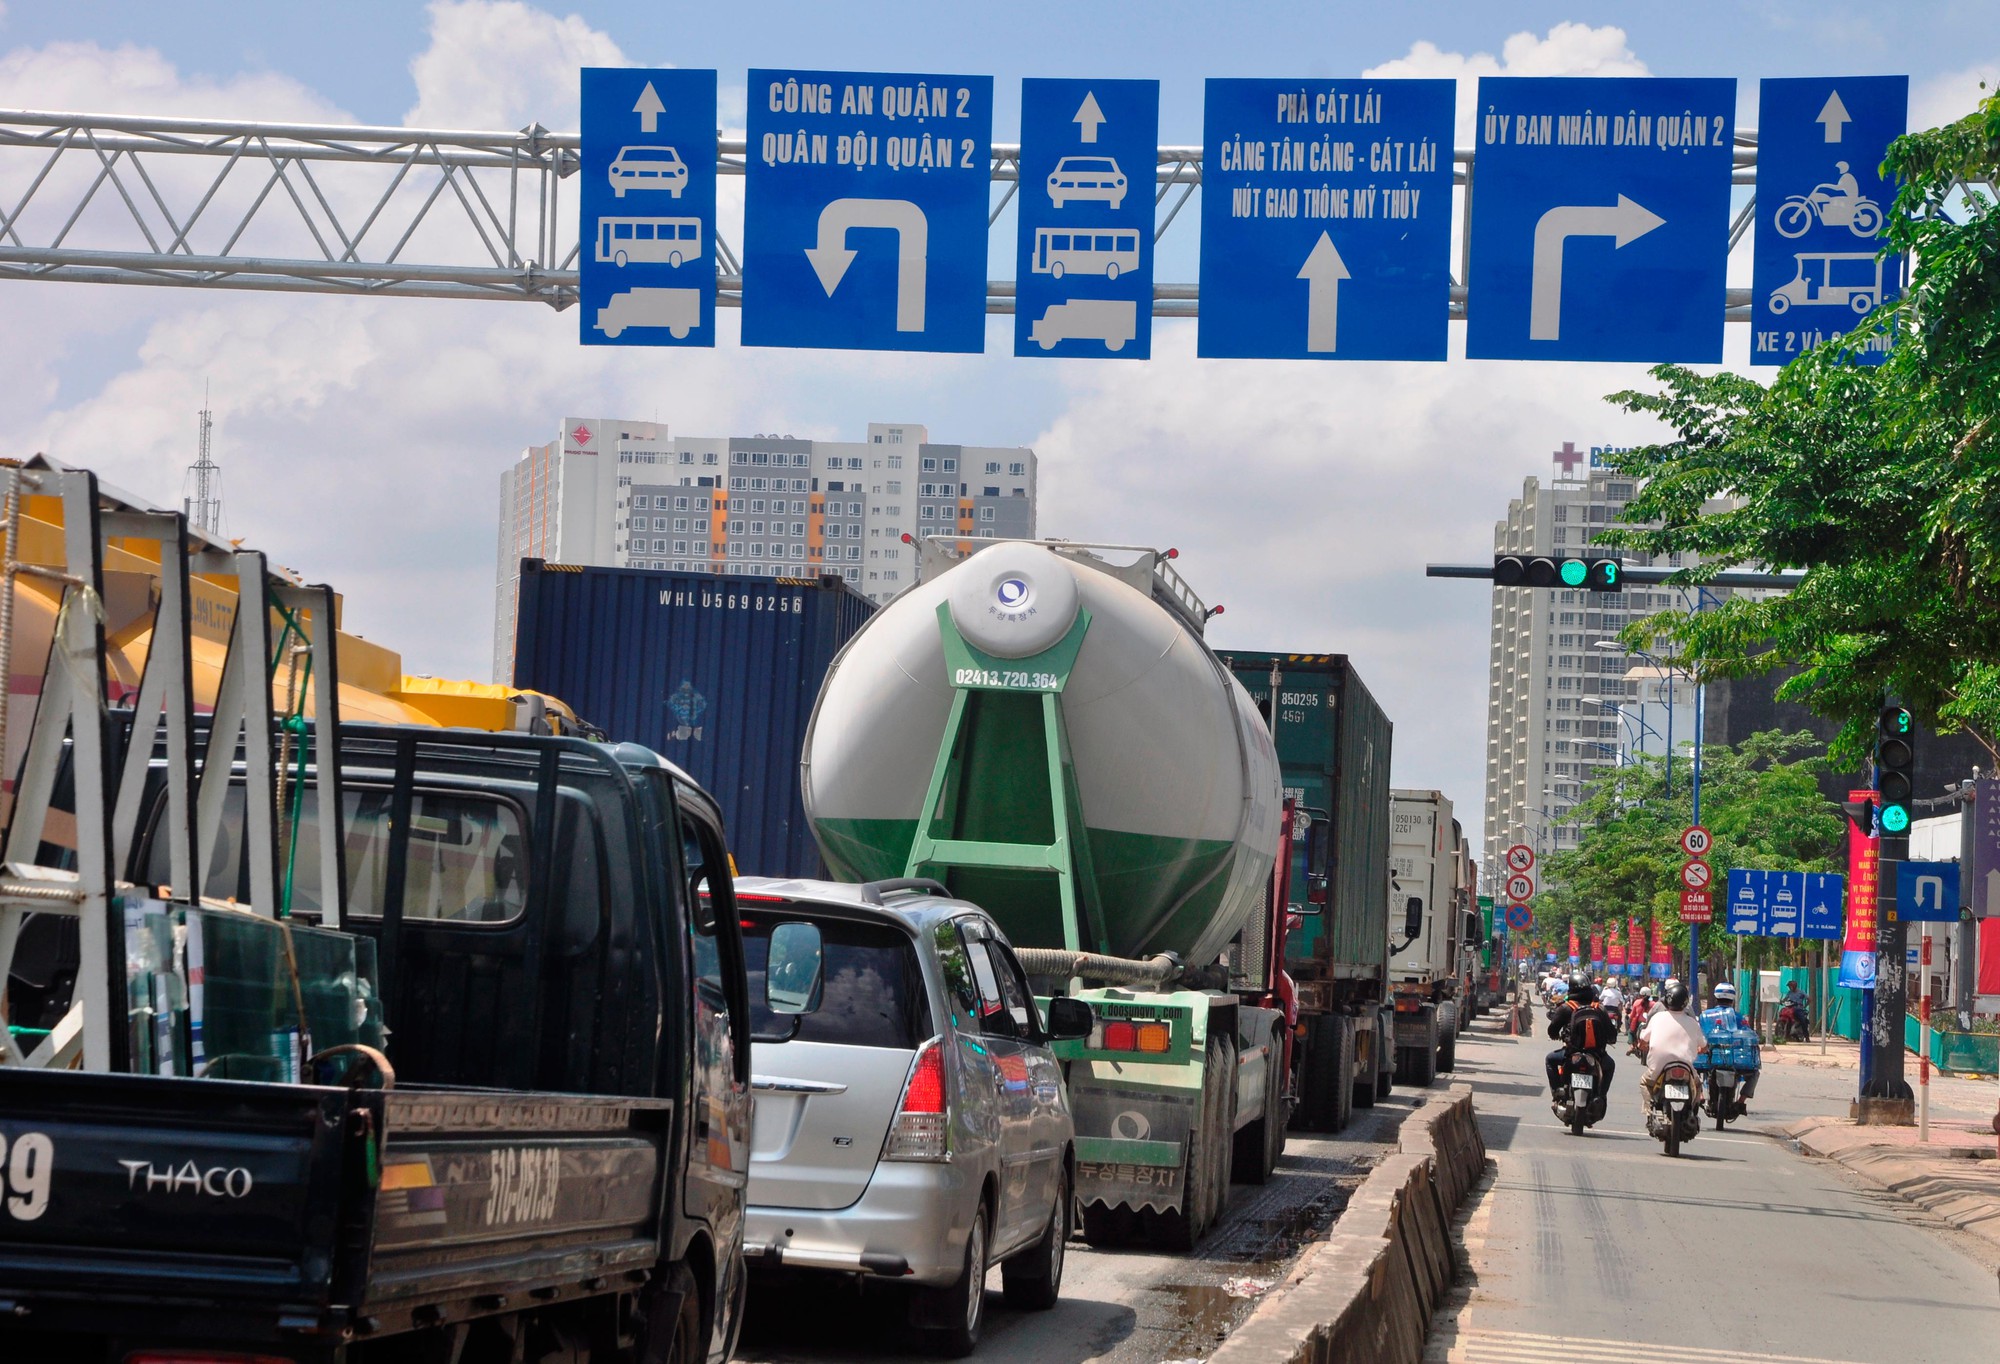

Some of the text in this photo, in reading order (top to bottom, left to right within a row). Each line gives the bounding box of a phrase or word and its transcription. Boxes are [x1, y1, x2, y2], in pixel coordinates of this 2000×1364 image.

[770, 78, 970, 123] CÔNG AN QUẬN 2
[1278, 88, 1380, 123] PHÀ CÁT LÁI
[1484, 106, 1724, 154] ỦY BAN NHÂN DÂN QUẬN 2
[763, 129, 974, 173] QUÂN ĐỘI QUẬN 2
[1221, 133, 1264, 171] CẢNG
[1272, 137, 1304, 171] TÂN
[1310, 134, 1353, 172] CẢNG
[1371, 137, 1403, 172] CÁT
[1409, 137, 1436, 171] LÁI
[1233, 181, 1420, 219] NÚT GIAO THÔNG MỸ THỦY
[1757, 332, 1779, 352] XE
[1785, 332, 1795, 352] 2
[1605, 564, 1616, 584] 9
[955, 668, 1058, 689] 02413.720.364
[1281, 692, 1319, 707] 850295
[1328, 694, 1336, 707] 9
[1281, 710, 1305, 723] 45G1
[1898, 713, 1908, 733] 9
[1395, 814, 1421, 824] 050130
[1395, 824, 1411, 833] 22G1
[1690, 834, 1704, 849] 60
[1514, 881, 1526, 894] 70
[1890, 912, 1897, 920] 2
[118, 1159, 253, 1198] THACO
